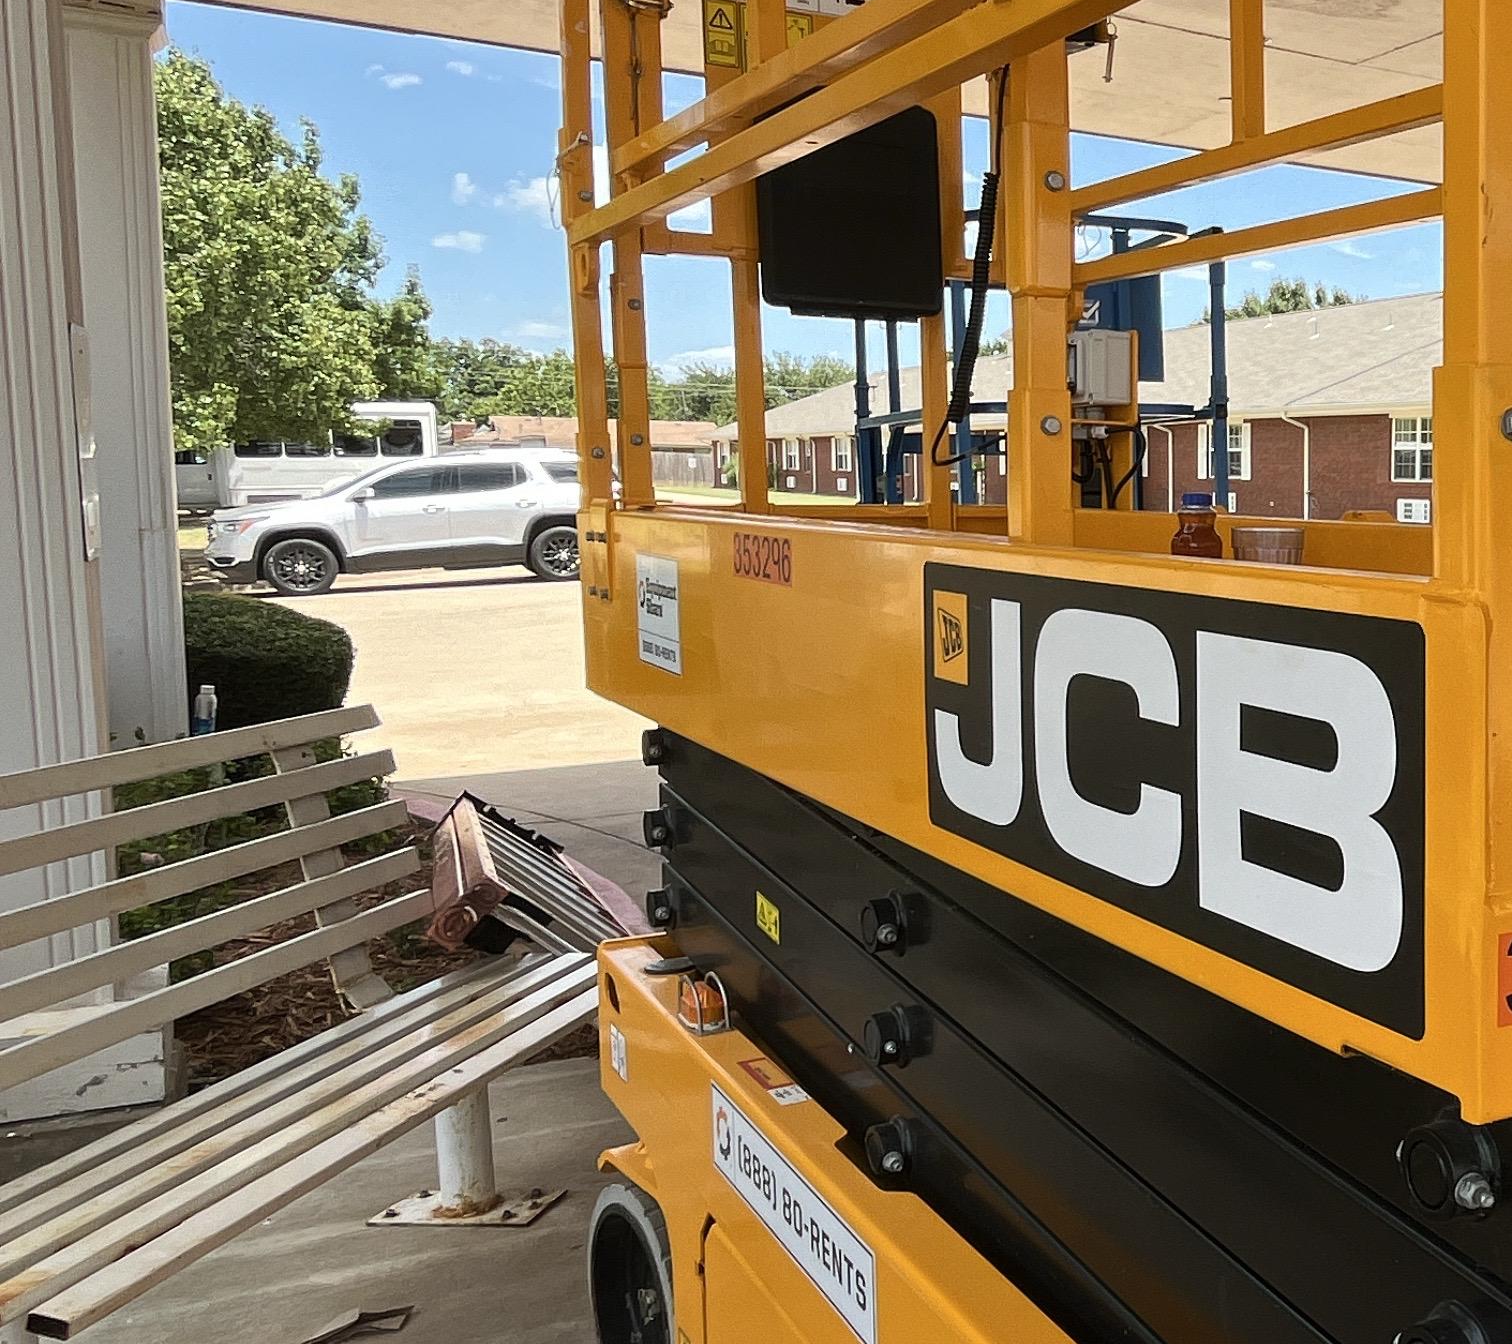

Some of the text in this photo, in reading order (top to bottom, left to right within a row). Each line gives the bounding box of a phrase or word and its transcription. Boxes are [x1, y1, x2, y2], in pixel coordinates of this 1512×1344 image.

[733, 532, 791, 583] 353296
[934, 598, 1403, 974] JCB
[736, 1134, 867, 1313] (888) 80-RENTS
